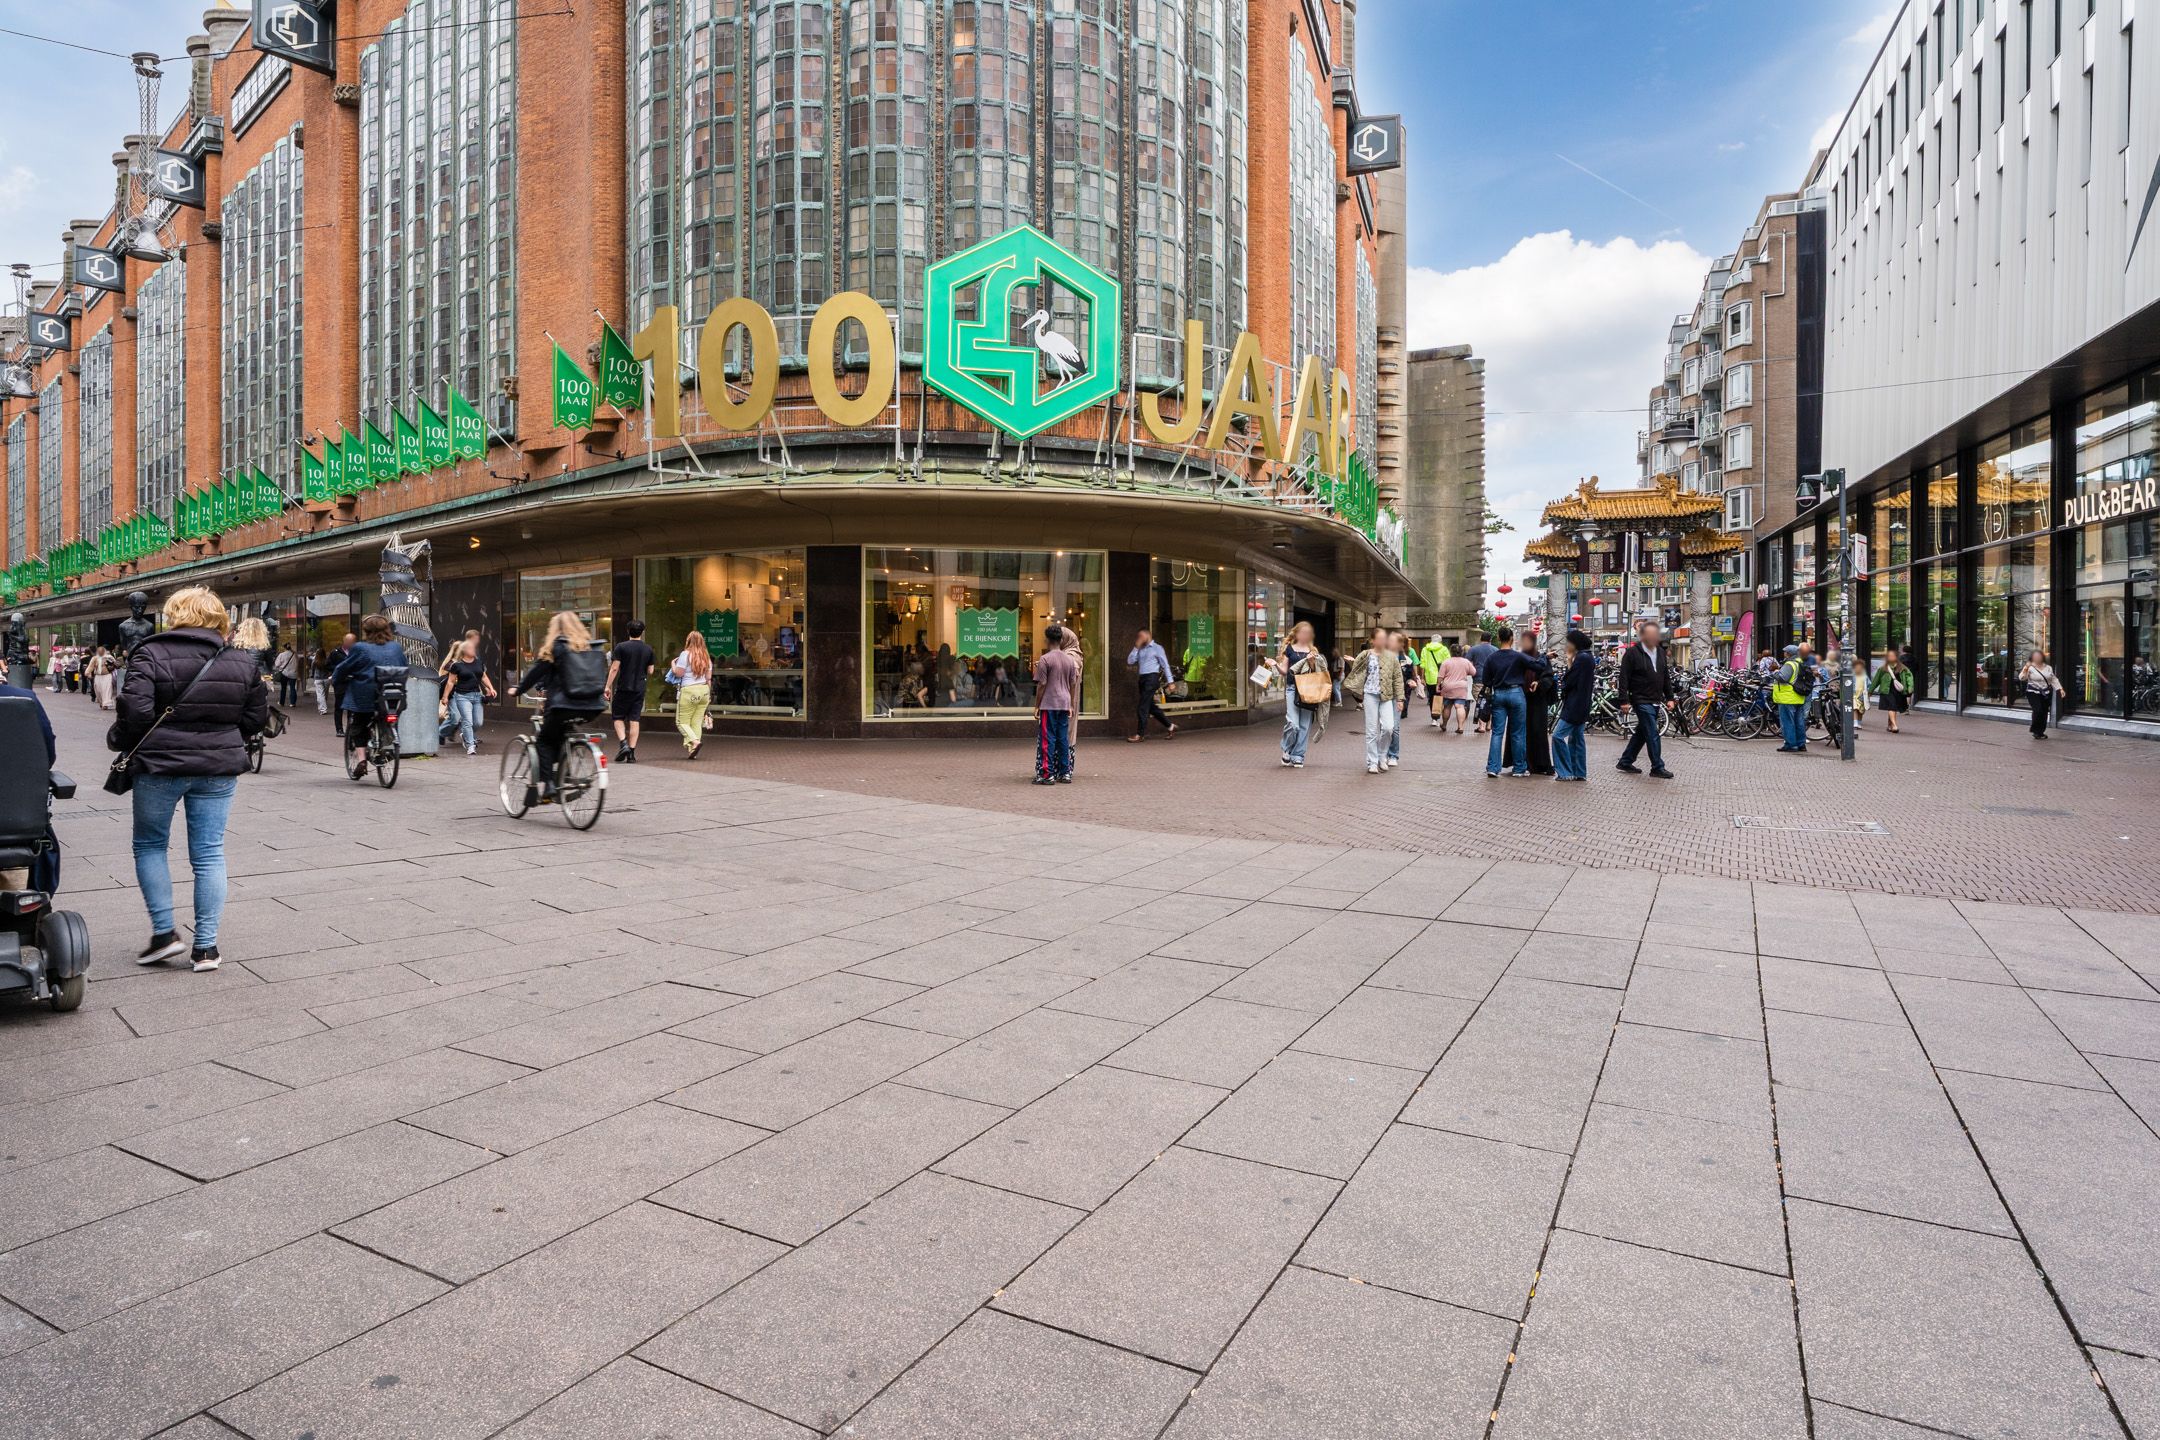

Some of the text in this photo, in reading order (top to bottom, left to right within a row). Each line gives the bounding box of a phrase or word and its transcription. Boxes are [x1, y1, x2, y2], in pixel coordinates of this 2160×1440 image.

[608, 357, 640, 376] 100
[608, 373, 637, 387] JAAR
[559, 378, 590, 396] 100
[634, 291, 1350, 485] 100 JAAR
[560, 395, 589, 407] JAAR
[454, 415, 482, 431] 100
[455, 430, 481, 440] JAAR
[371, 444, 396, 457] 100
[402, 448, 419, 457] JAA
[329, 459, 342, 471] 10
[372, 456, 395, 465] JAAR
[307, 468, 325, 479] 10
[330, 470, 340, 478] JA
[348, 464, 365, 473] JAA
[309, 479, 325, 487] JAA
[241, 490, 253, 500] 10
[257, 485, 280, 496] 100
[258, 495, 278, 503] JAAR
[2064, 477, 2157, 527] PULL&BEAR
[150, 524, 168, 532] 100
